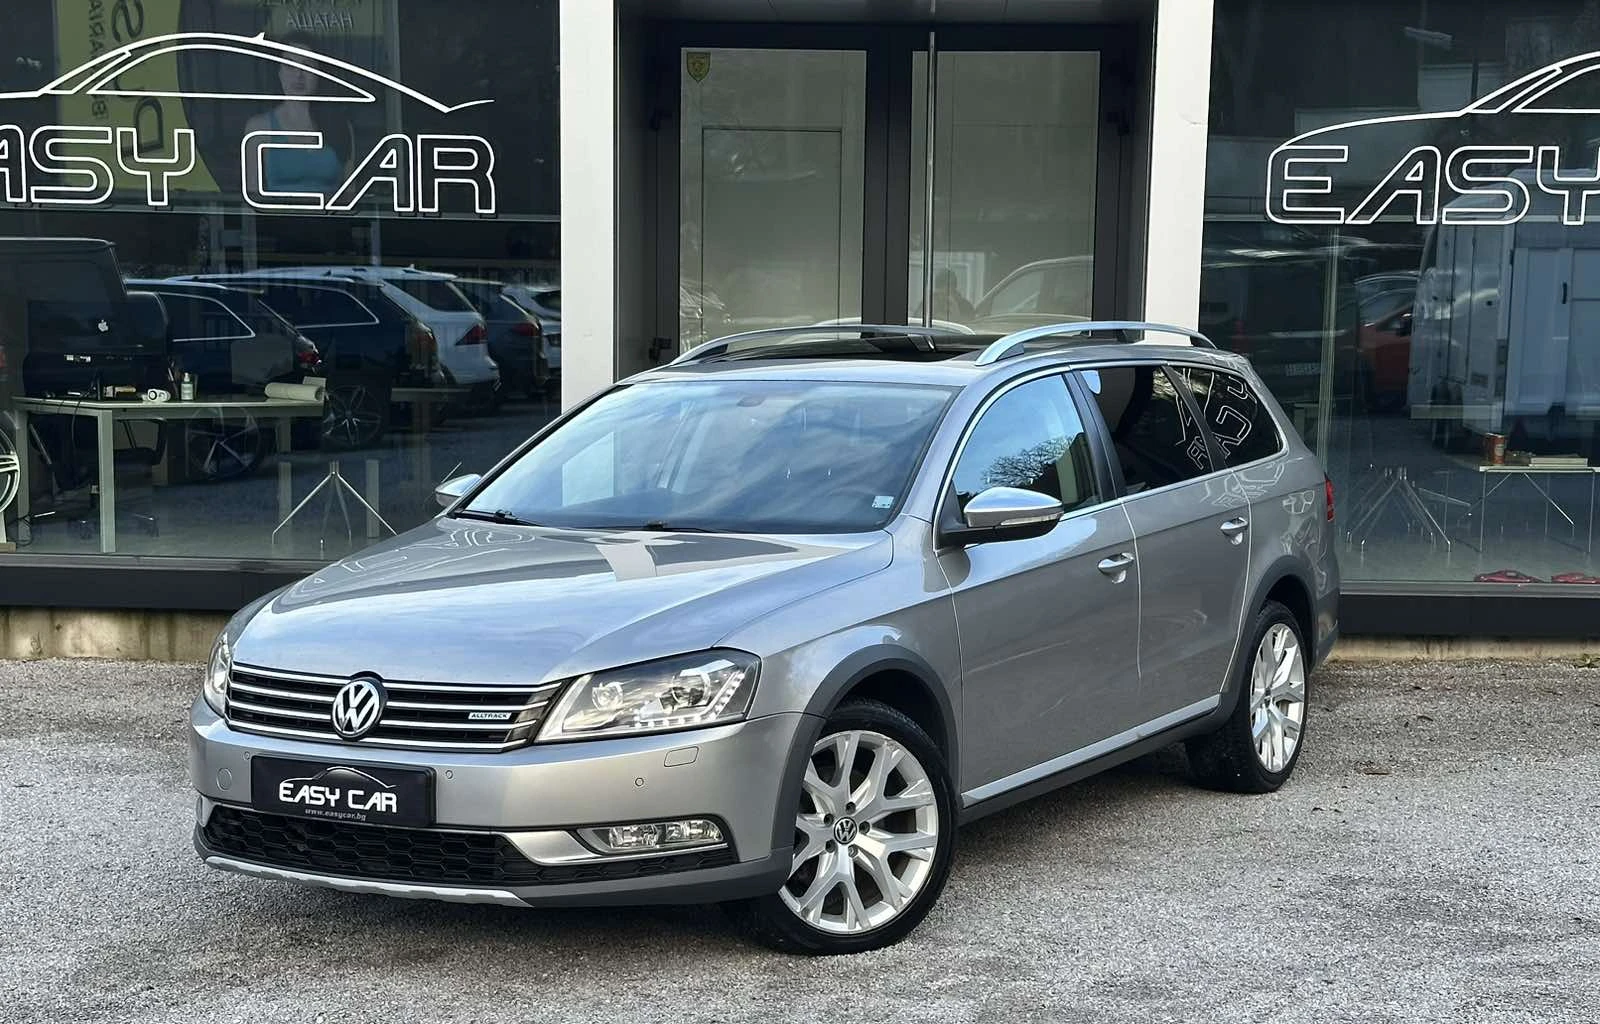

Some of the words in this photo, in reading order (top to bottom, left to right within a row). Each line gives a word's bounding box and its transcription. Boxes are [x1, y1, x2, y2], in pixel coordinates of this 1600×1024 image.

[241, 130, 496, 214] CAR
[1266, 145, 1600, 226] EASY
[332, 680, 380, 735] VW
[279, 782, 340, 807] EASY
[348, 789, 398, 813] CAR
[305, 808, 367, 821] www.easycar.bg
